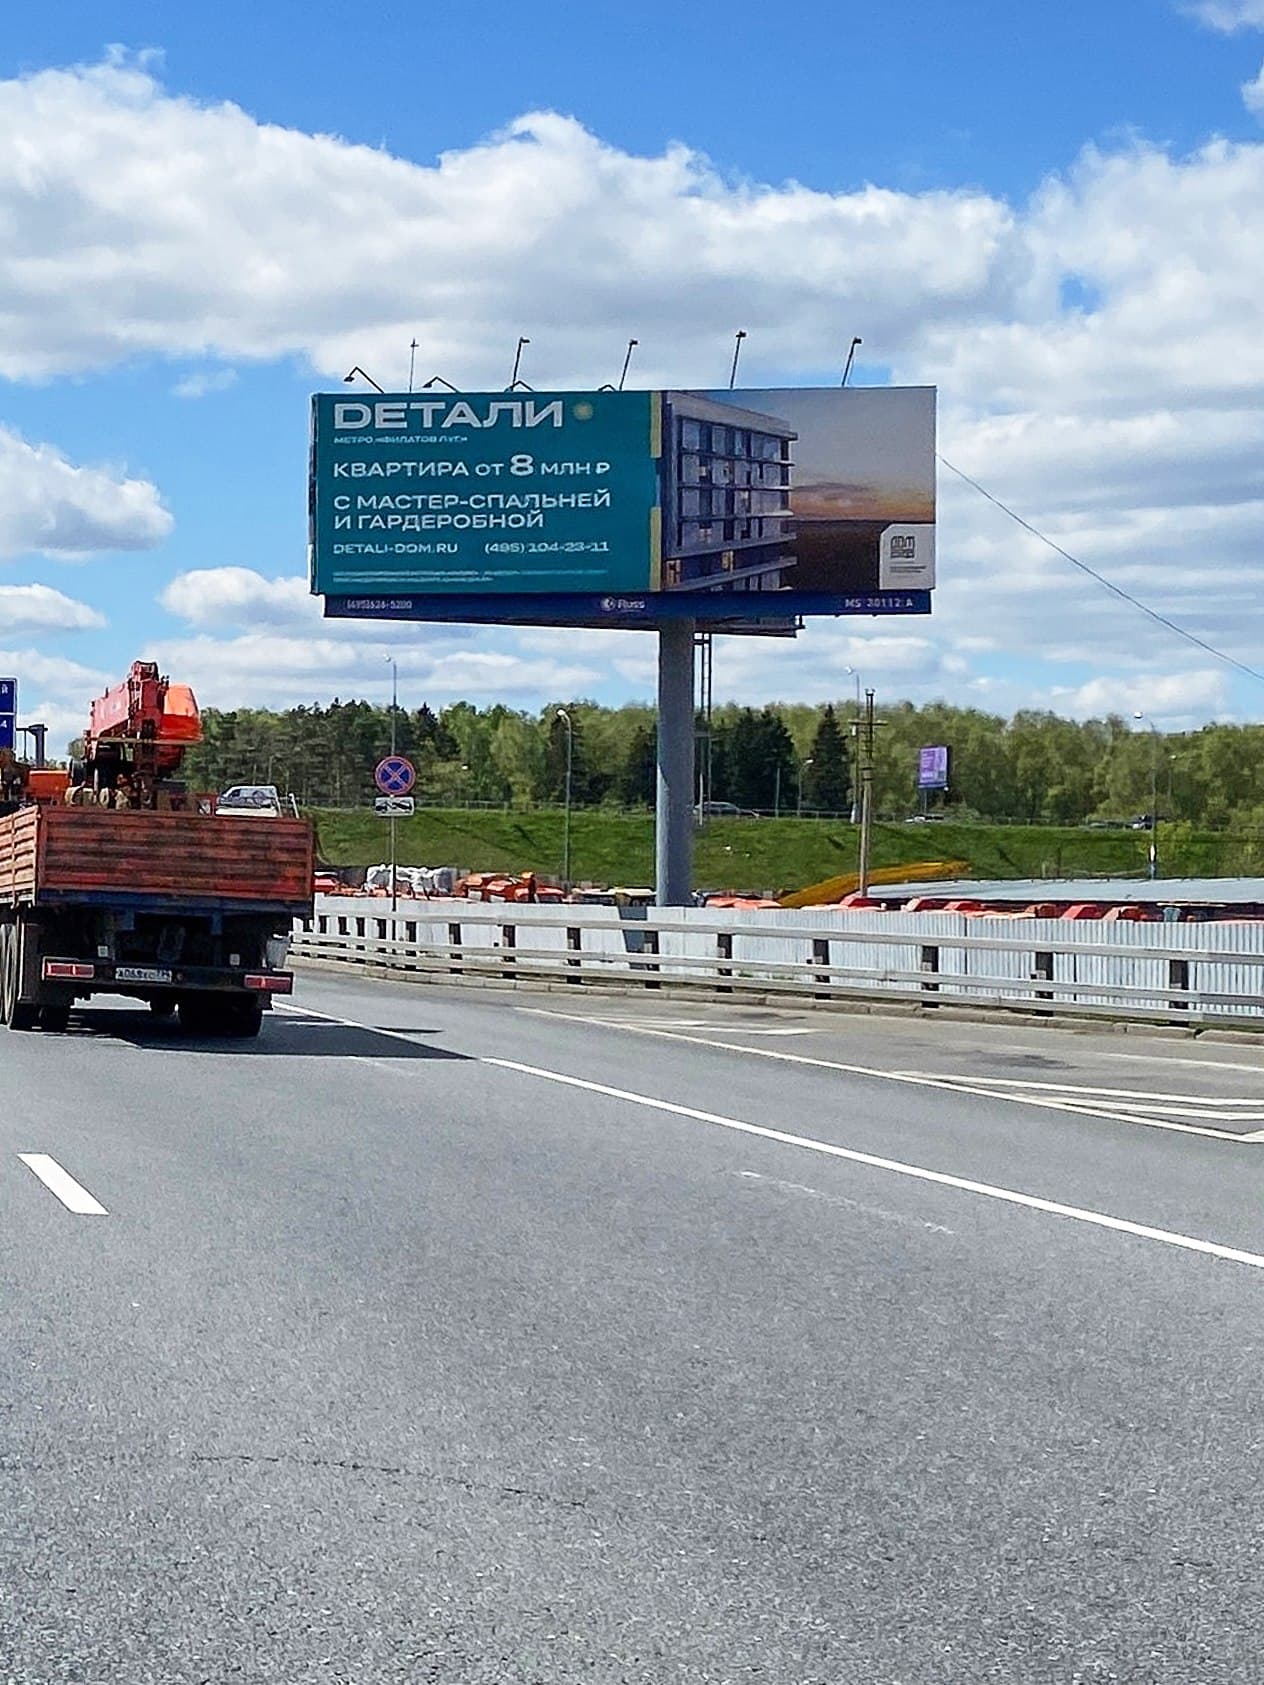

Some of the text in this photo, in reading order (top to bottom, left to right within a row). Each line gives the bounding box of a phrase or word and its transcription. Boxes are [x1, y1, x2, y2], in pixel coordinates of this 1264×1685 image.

[333, 461, 470, 478] КВАРТИРА
[510, 453, 535, 476] 8
[333, 488, 611, 510] С МАСТЕР-СПАЛЬНЕЙ
[334, 509, 544, 532] И ГАРДЕРОБНОЙ
[333, 543, 458, 554] DETALI-DOM.RU
[484, 540, 610, 555] (495) 104-23-11
[905, 598, 914, 607] A
